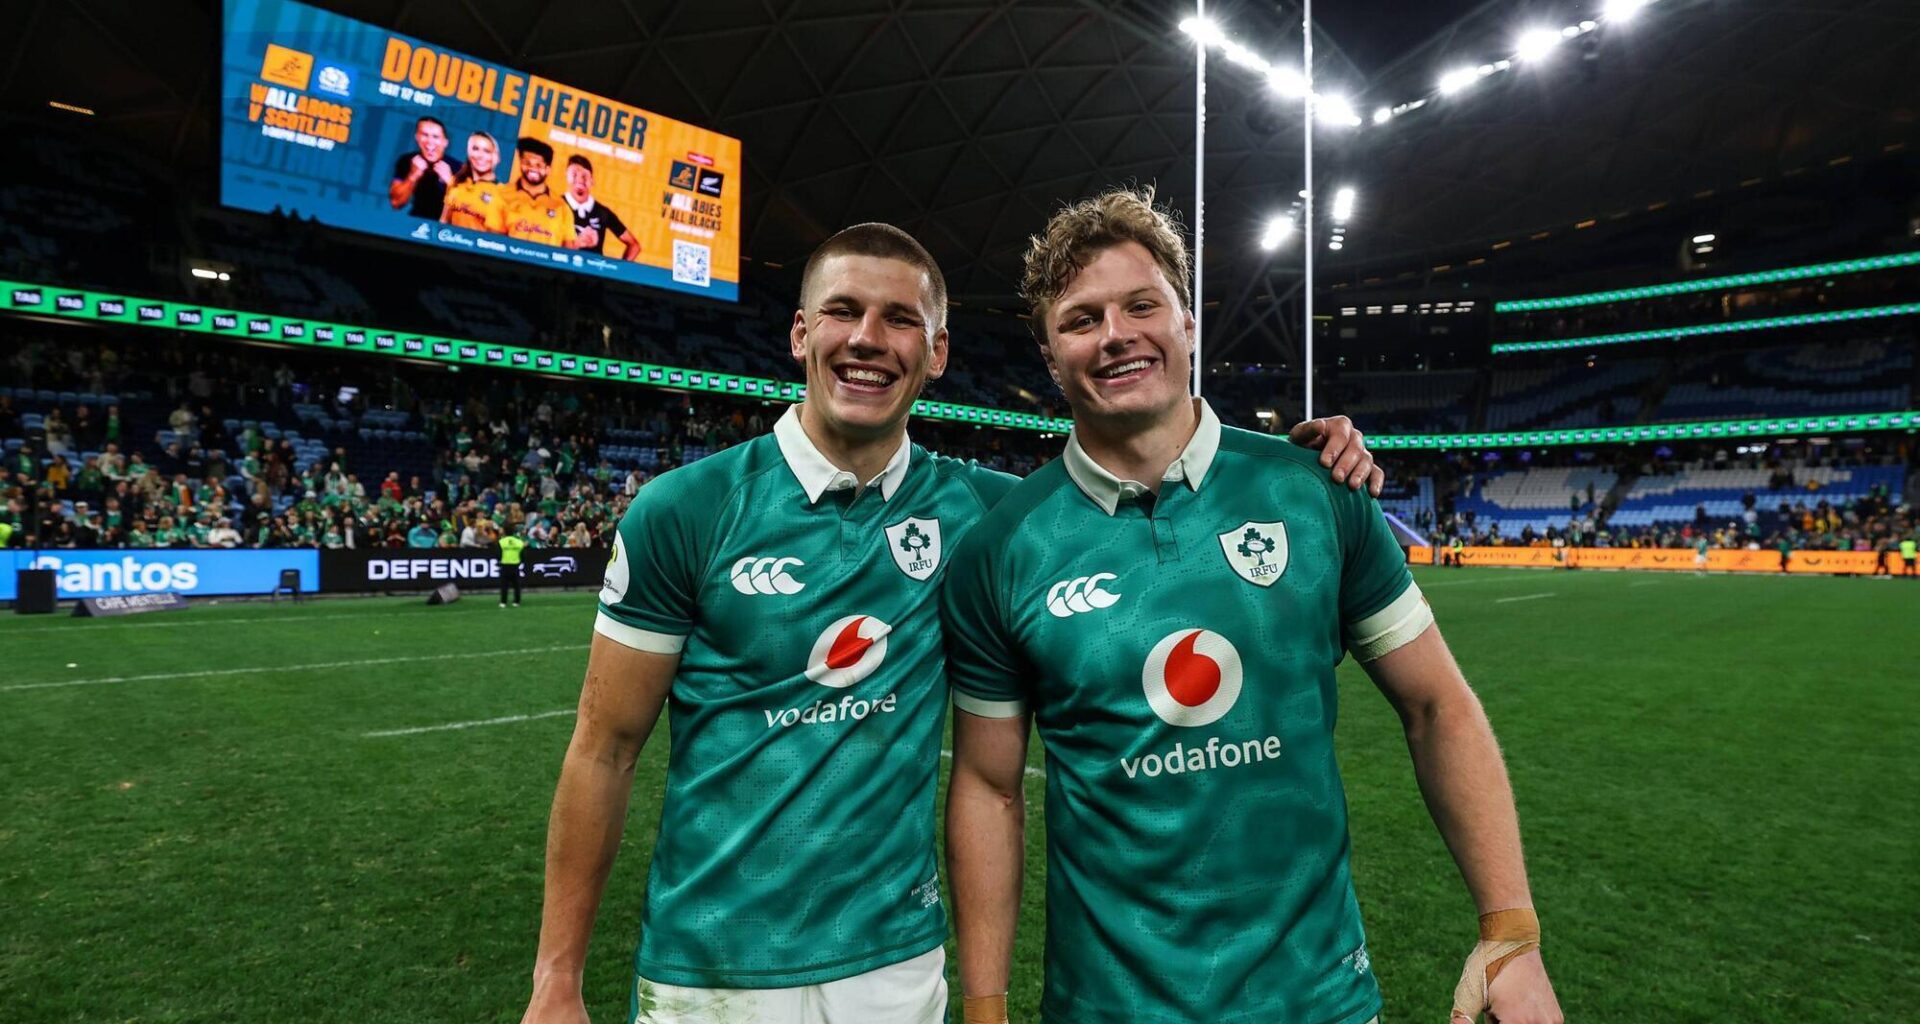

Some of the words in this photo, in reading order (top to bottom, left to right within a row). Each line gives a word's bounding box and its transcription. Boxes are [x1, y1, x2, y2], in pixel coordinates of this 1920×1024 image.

[381, 37, 525, 116] DOUBLE
[531, 84, 648, 150] HEADER
[264, 107, 350, 143] SCOTLAND
[368, 559, 525, 580] DEFENDE
[909, 559, 933, 573] IRFU
[1249, 564, 1278, 578] IRFU
[1120, 735, 1282, 779] vodafone
